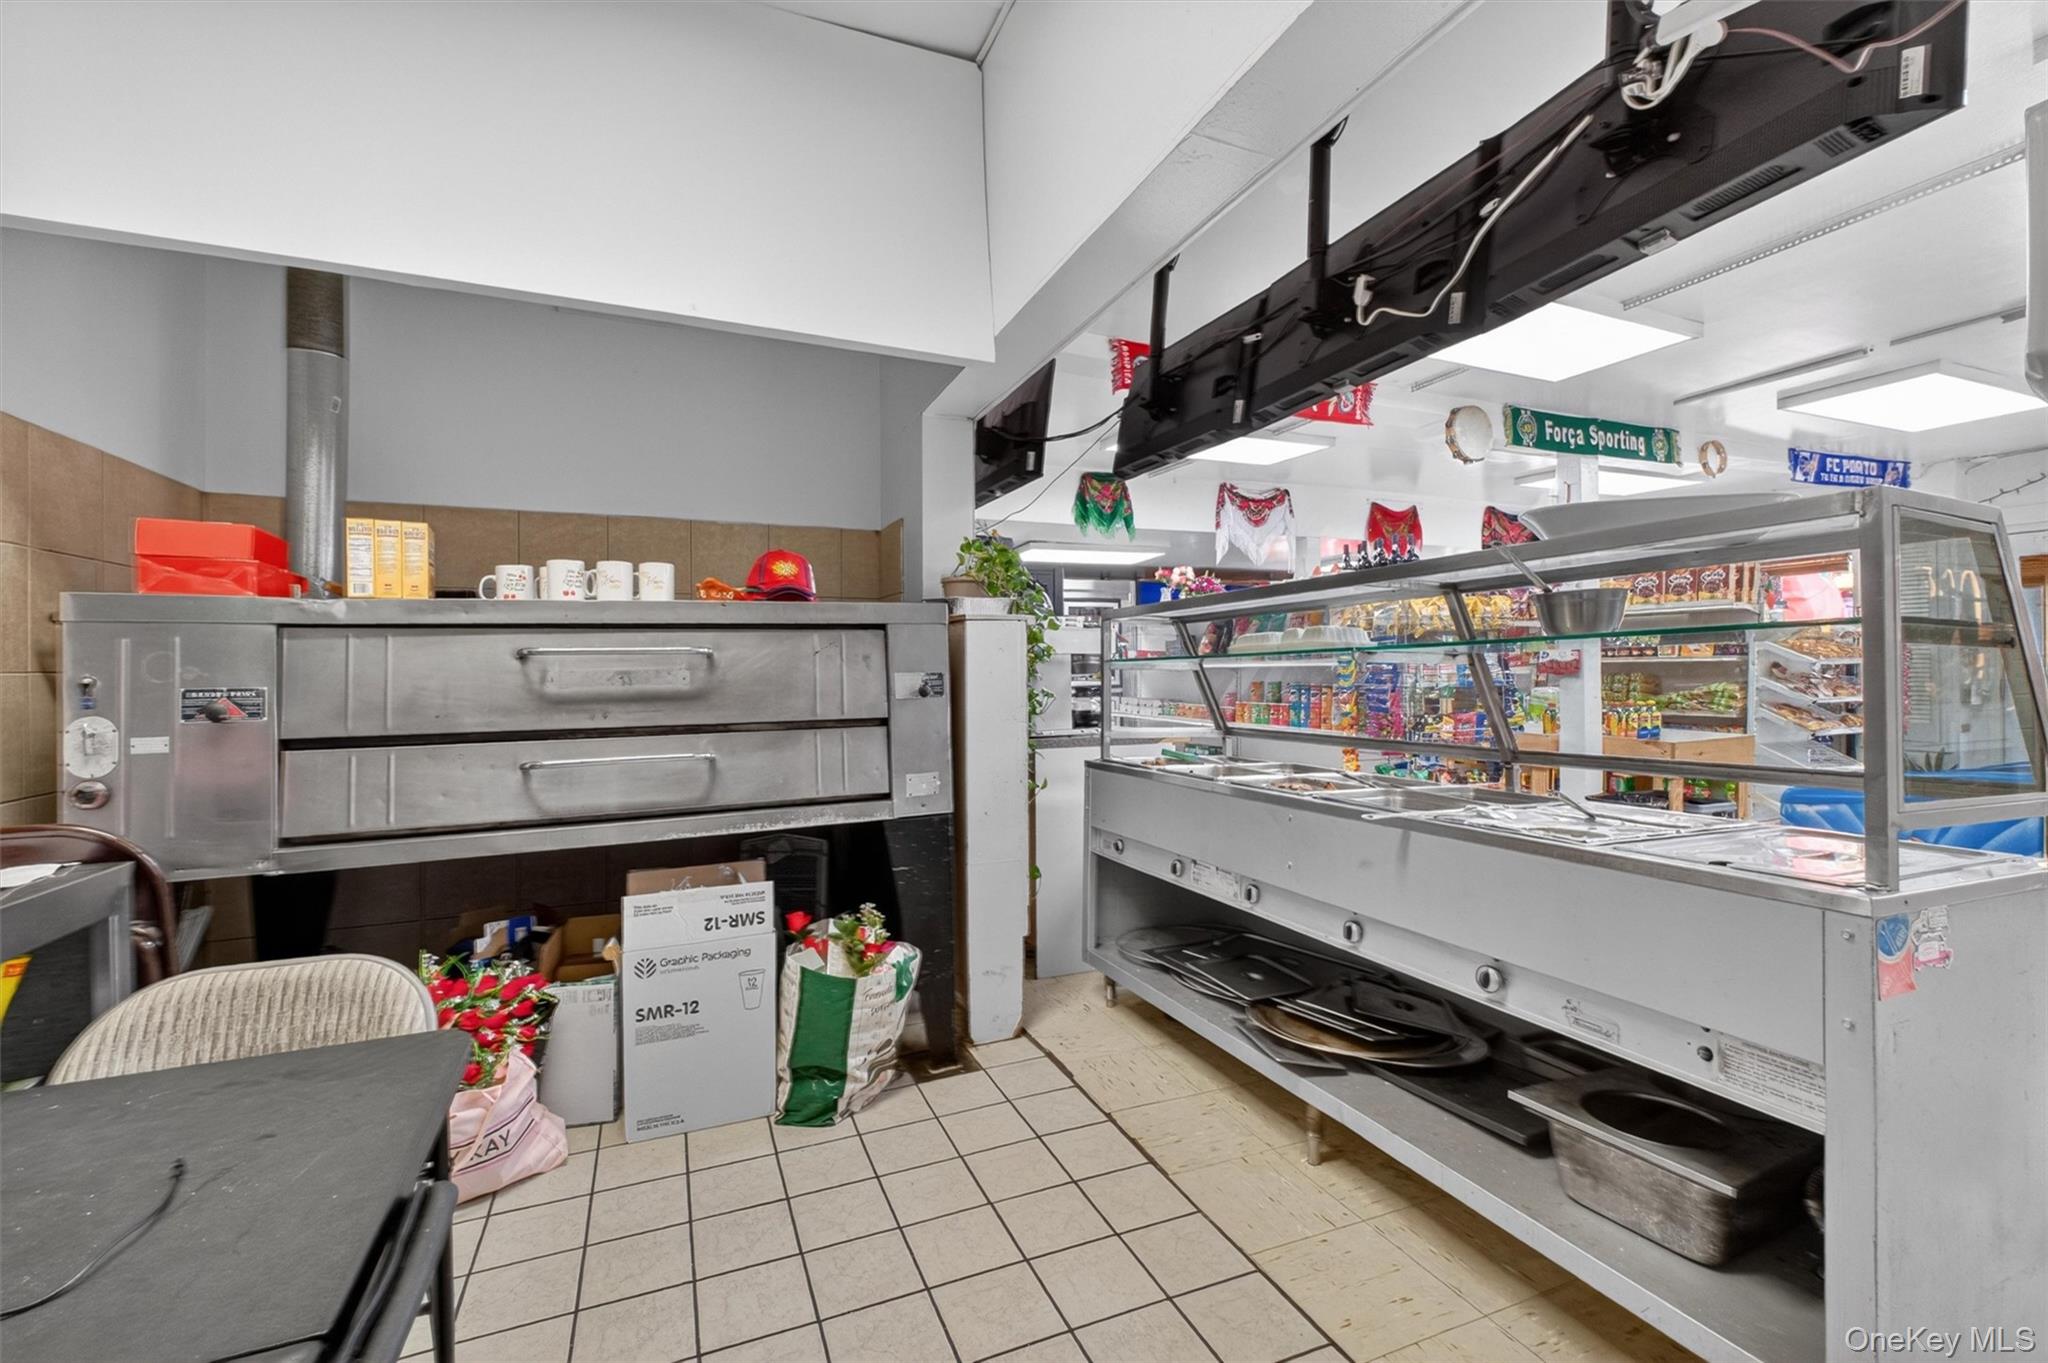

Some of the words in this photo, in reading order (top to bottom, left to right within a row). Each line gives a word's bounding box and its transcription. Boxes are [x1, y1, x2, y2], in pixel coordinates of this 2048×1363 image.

[1545, 420, 1586, 448] Força
[1589, 425, 1646, 456] Sporting
[1826, 457, 1841, 473] FC
[1842, 459, 1878, 475] PORTO
[704, 911, 766, 932] SMR-12
[701, 948, 752, 963] Packaging
[635, 1000, 700, 1023] SMR-12
